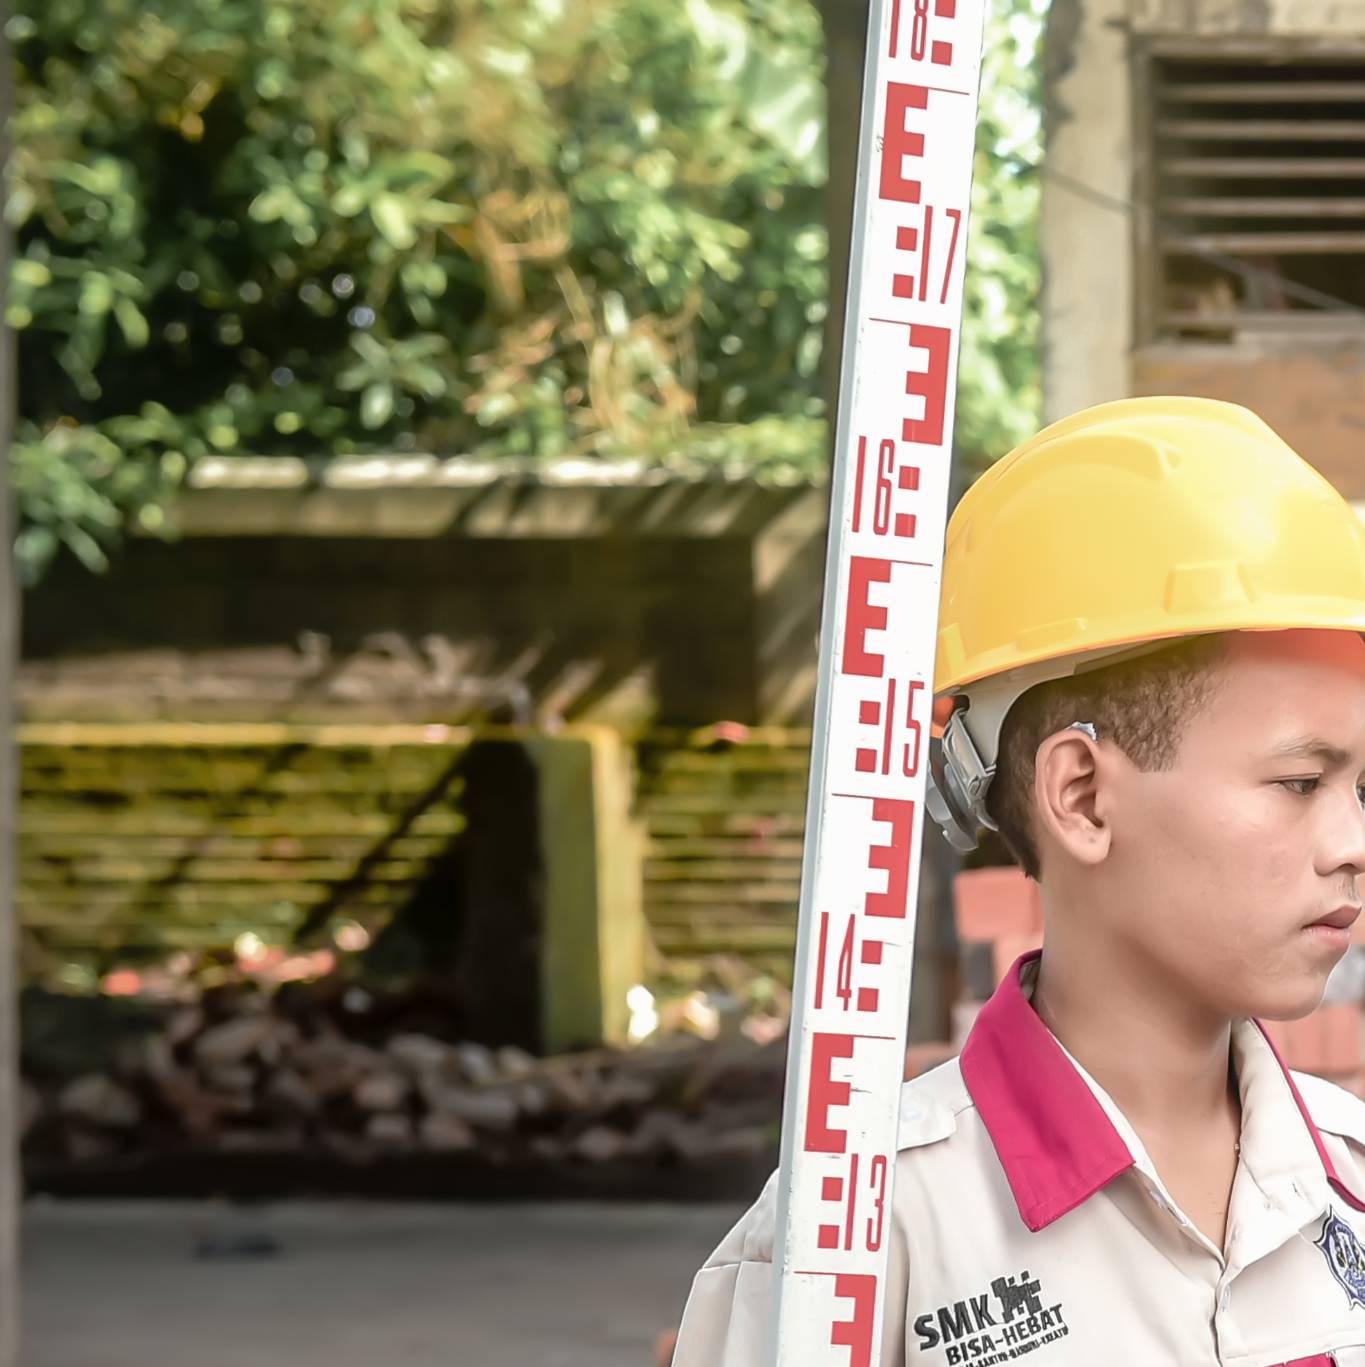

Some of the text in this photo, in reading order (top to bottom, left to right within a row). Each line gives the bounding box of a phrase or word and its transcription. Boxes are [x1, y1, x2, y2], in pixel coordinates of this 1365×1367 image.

[918, 206, 961, 304] 17
[851, 435, 895, 536] 16
[881, 678, 925, 778] 15
[815, 911, 856, 1011] 14
[844, 1153, 888, 1253] 13
[914, 1293, 999, 1351] SMK
[945, 1303, 1063, 1367] BISA-HEBAT
